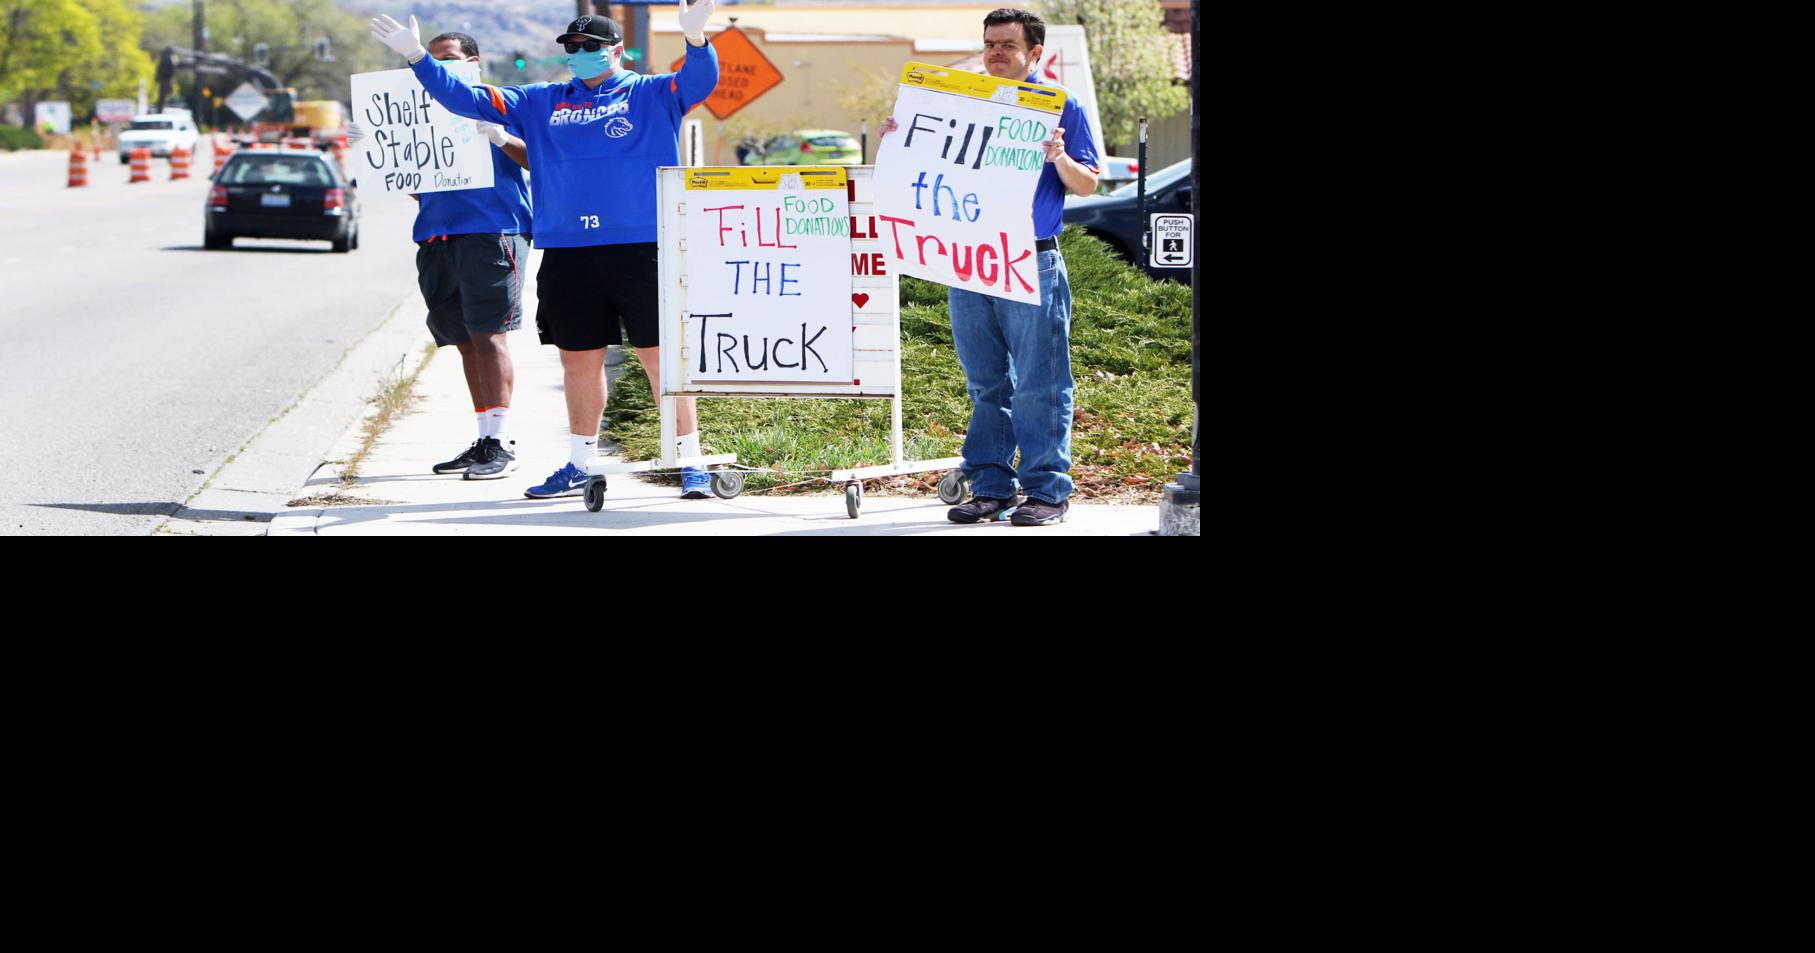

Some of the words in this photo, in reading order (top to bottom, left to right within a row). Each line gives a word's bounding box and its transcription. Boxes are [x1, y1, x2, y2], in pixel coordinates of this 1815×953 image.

[366, 89, 433, 127] Shelf
[549, 99, 630, 127] BRONCOS
[366, 126, 455, 170] Stable
[904, 113, 994, 170] Fill
[997, 116, 1048, 143] FOOD
[385, 172, 422, 191] FOOD
[911, 172, 982, 223] the
[784, 195, 835, 214] FOOD
[580, 215, 600, 230] 73
[785, 216, 850, 238] DONATIONS
[850, 252, 887, 276] ME
[878, 214, 1036, 295] Truck
[725, 260, 802, 297] THE
